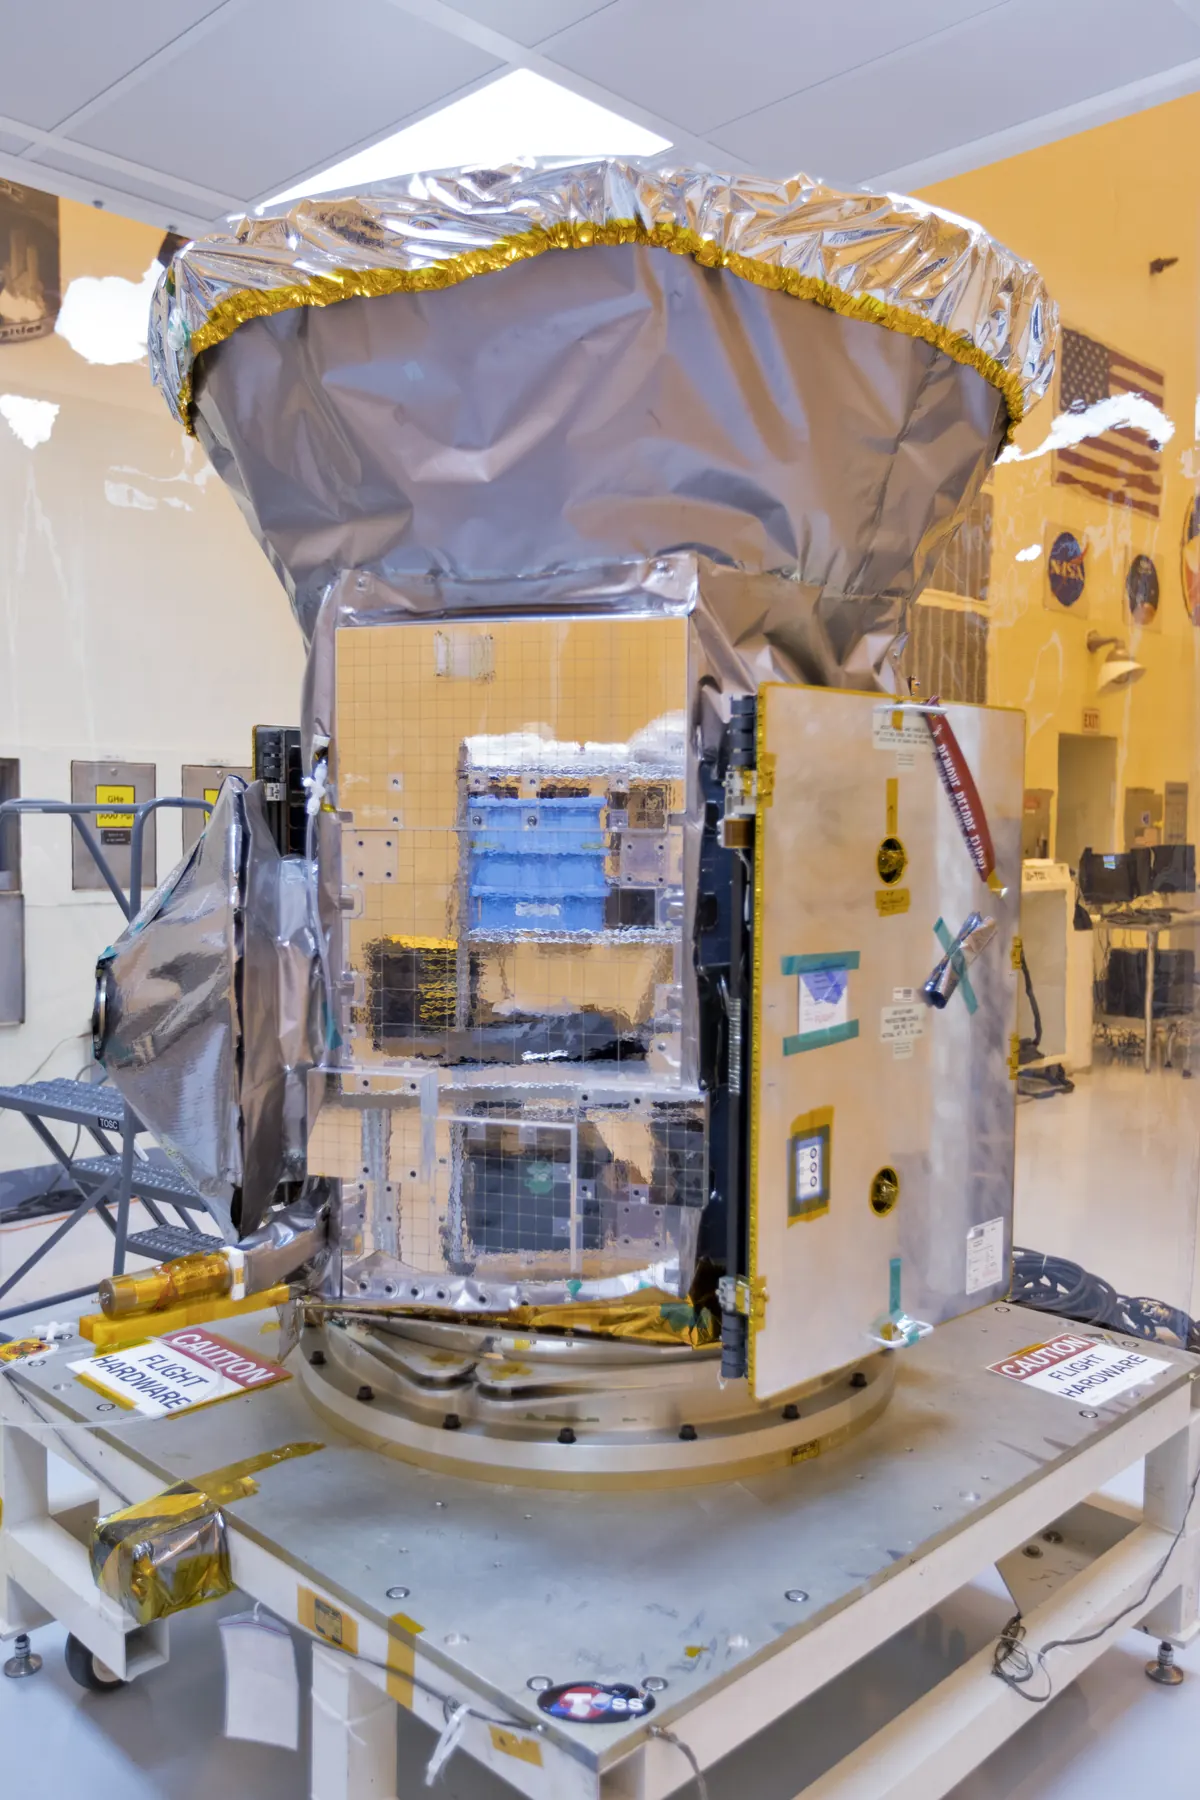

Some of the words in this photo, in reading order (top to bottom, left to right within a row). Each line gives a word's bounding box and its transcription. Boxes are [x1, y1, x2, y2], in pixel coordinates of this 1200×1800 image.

[1050, 559, 1084, 581] NASA
[1084, 712, 1100, 729] EXIT
[107, 795, 124, 804] GHe
[100, 1117, 118, 1130] TOSC
[138, 1354, 209, 1388] FLIGHT
[171, 1333, 277, 1385] CAUTION
[1001, 1336, 1090, 1377] CAUTION
[1048, 1354, 1106, 1382] FLIGHT
[90, 1355, 192, 1409] HARDWARE
[1058, 1354, 1148, 1398] HARDWARE
